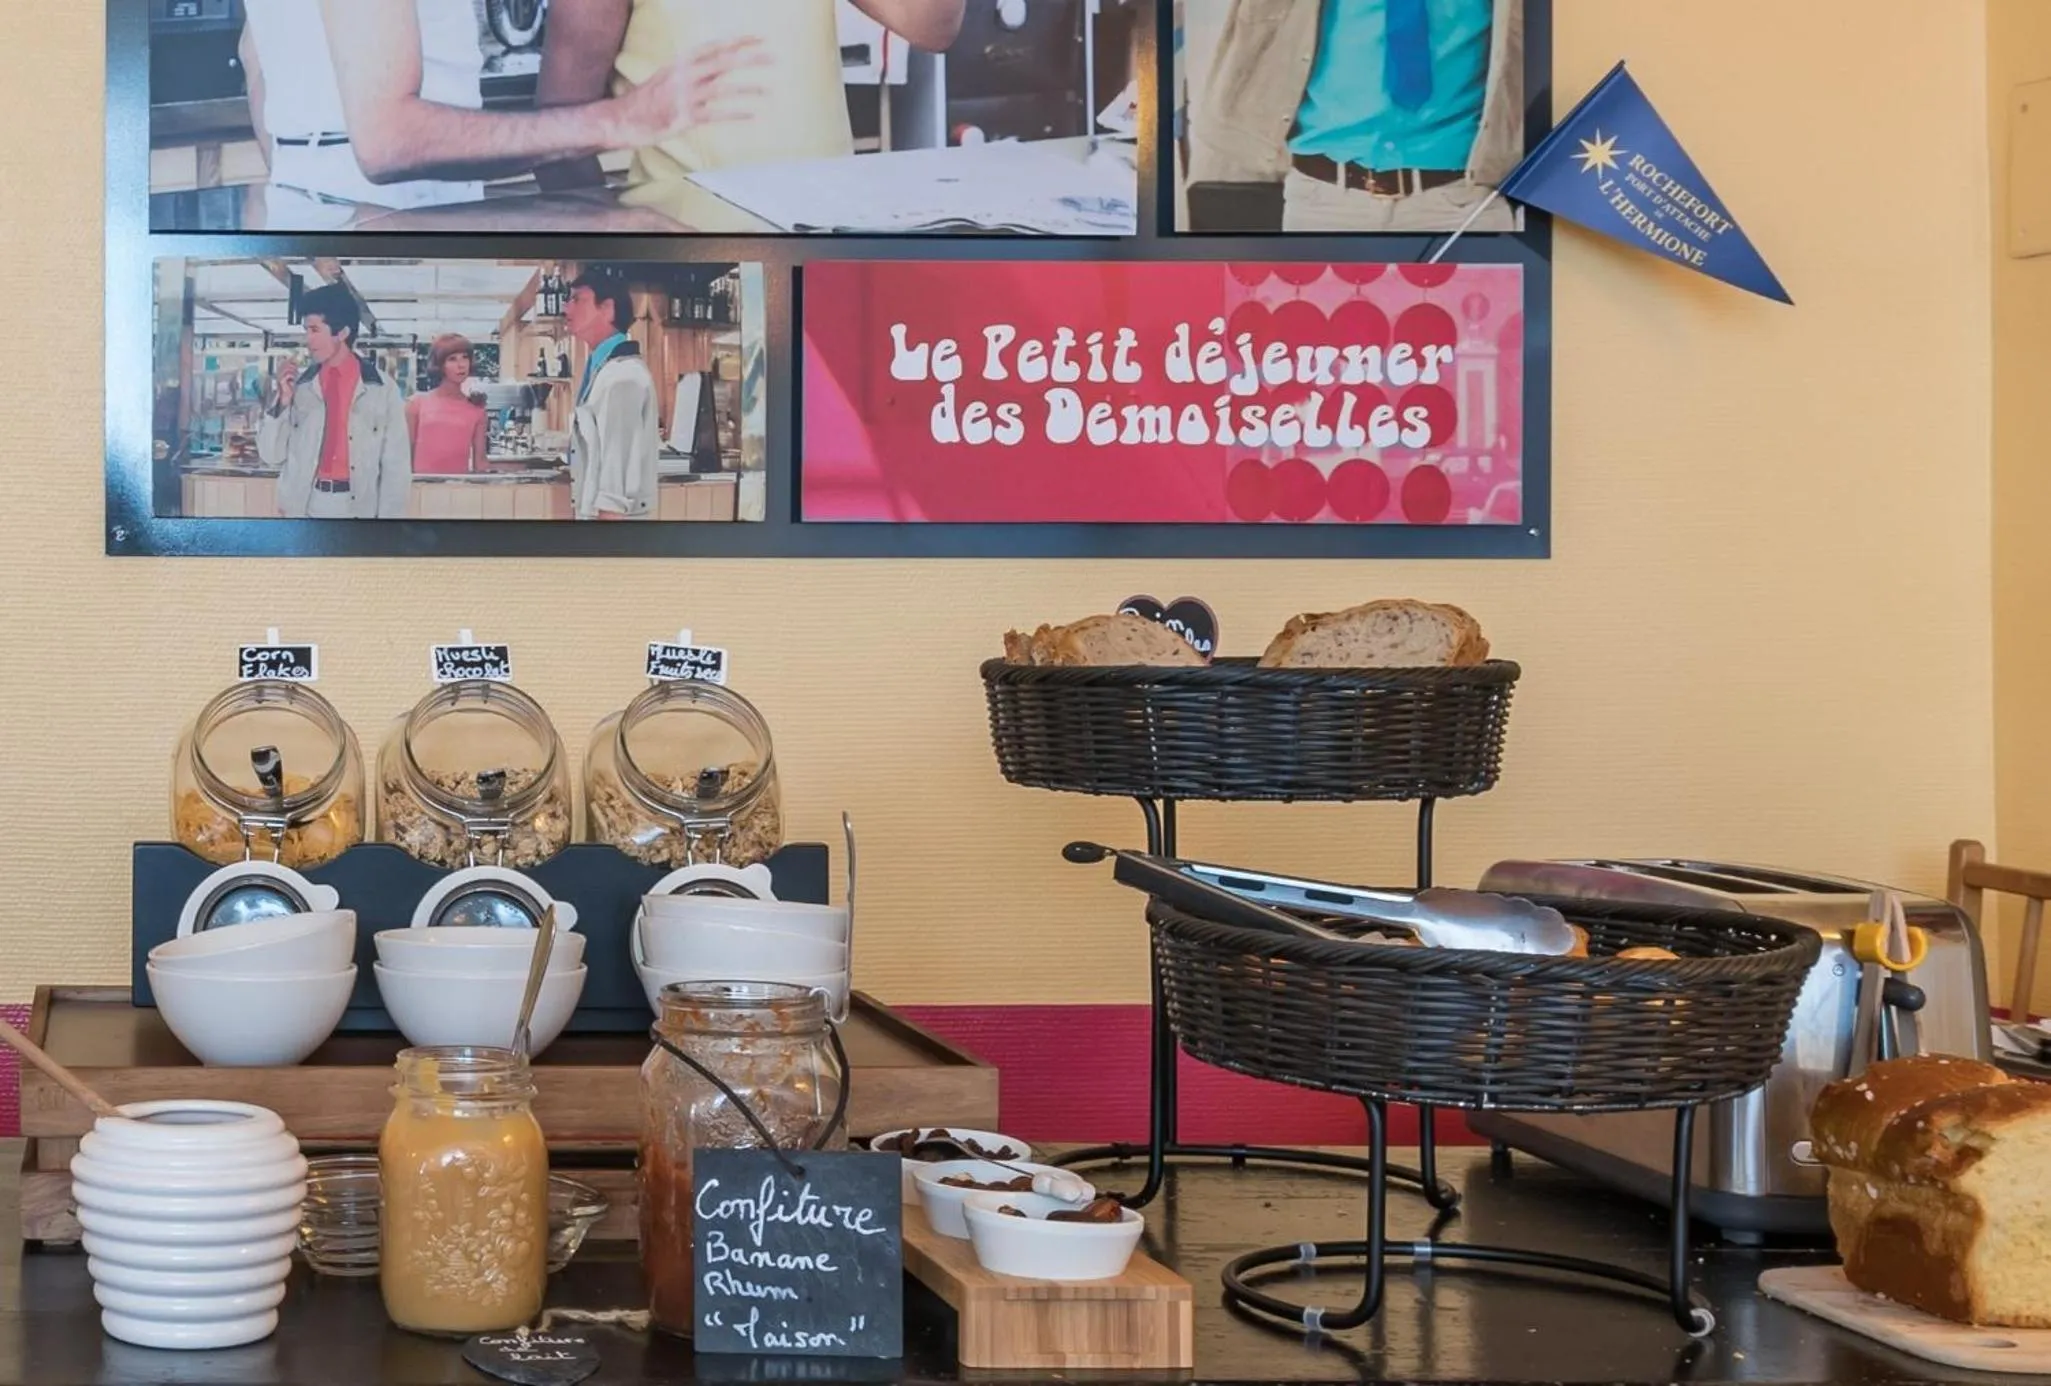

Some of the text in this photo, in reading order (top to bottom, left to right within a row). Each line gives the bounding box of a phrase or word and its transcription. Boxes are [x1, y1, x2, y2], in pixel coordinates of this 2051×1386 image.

[1599, 178, 1708, 266] L'HERMIONE
[1625, 172, 1713, 243] PORT D'ATTACHE
[1628, 153, 1733, 235] ROCHEFORT
[890, 317, 1454, 396] Le Petit déjeuner
[930, 384, 1432, 449] des Demoiselles
[241, 647, 296, 663] Corn
[695, 1175, 887, 1247] Confiture
[703, 1269, 799, 1300] Rhum
[705, 1230, 839, 1272] Banane
